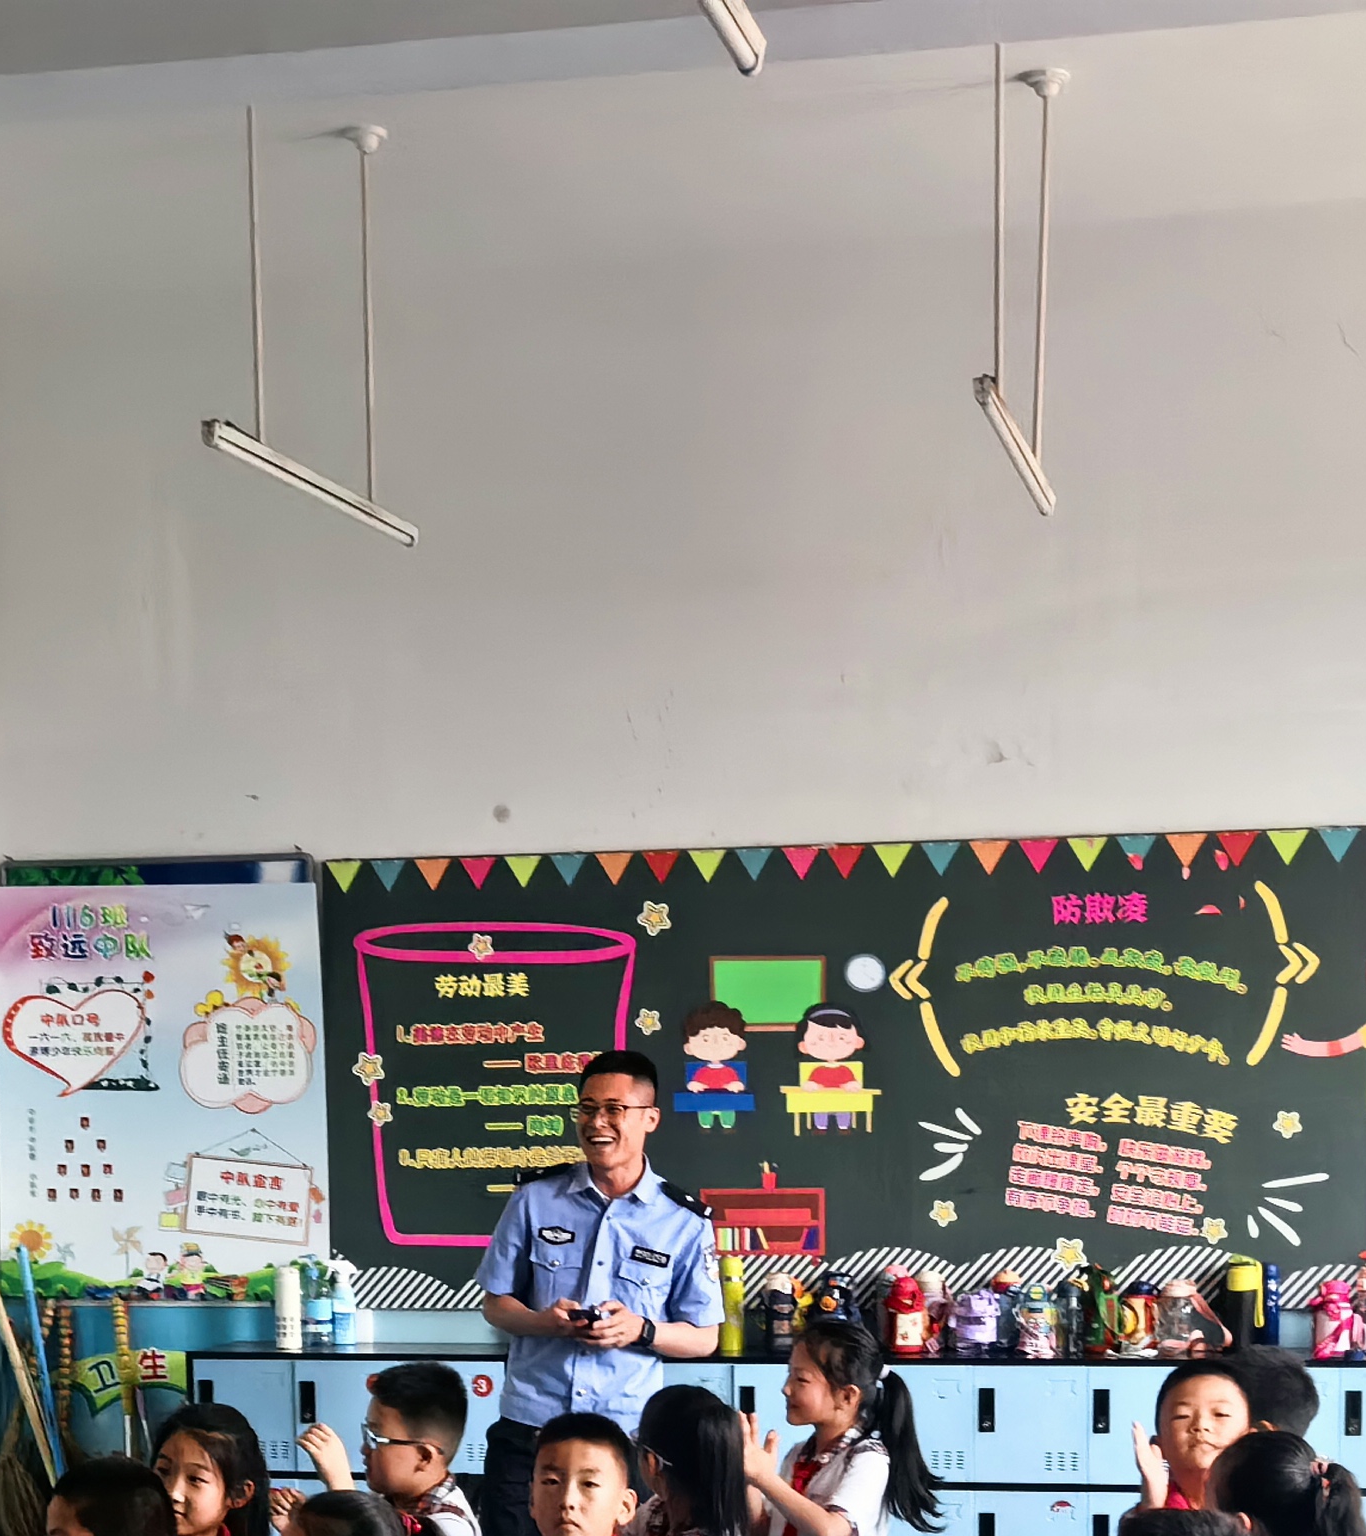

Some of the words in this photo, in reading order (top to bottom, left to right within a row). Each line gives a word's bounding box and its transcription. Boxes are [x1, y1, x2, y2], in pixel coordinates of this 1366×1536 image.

[51, 904, 129, 929] 116班
[1050, 892, 1149, 926] 防欺凌
[29, 932, 153, 961] 致远中队
[434, 972, 530, 998] 劳动最美
[40, 1013, 101, 1028] 中队口号
[1065, 1092, 1239, 1144] 安全最重要
[87, 1346, 169, 1395] 卫生
